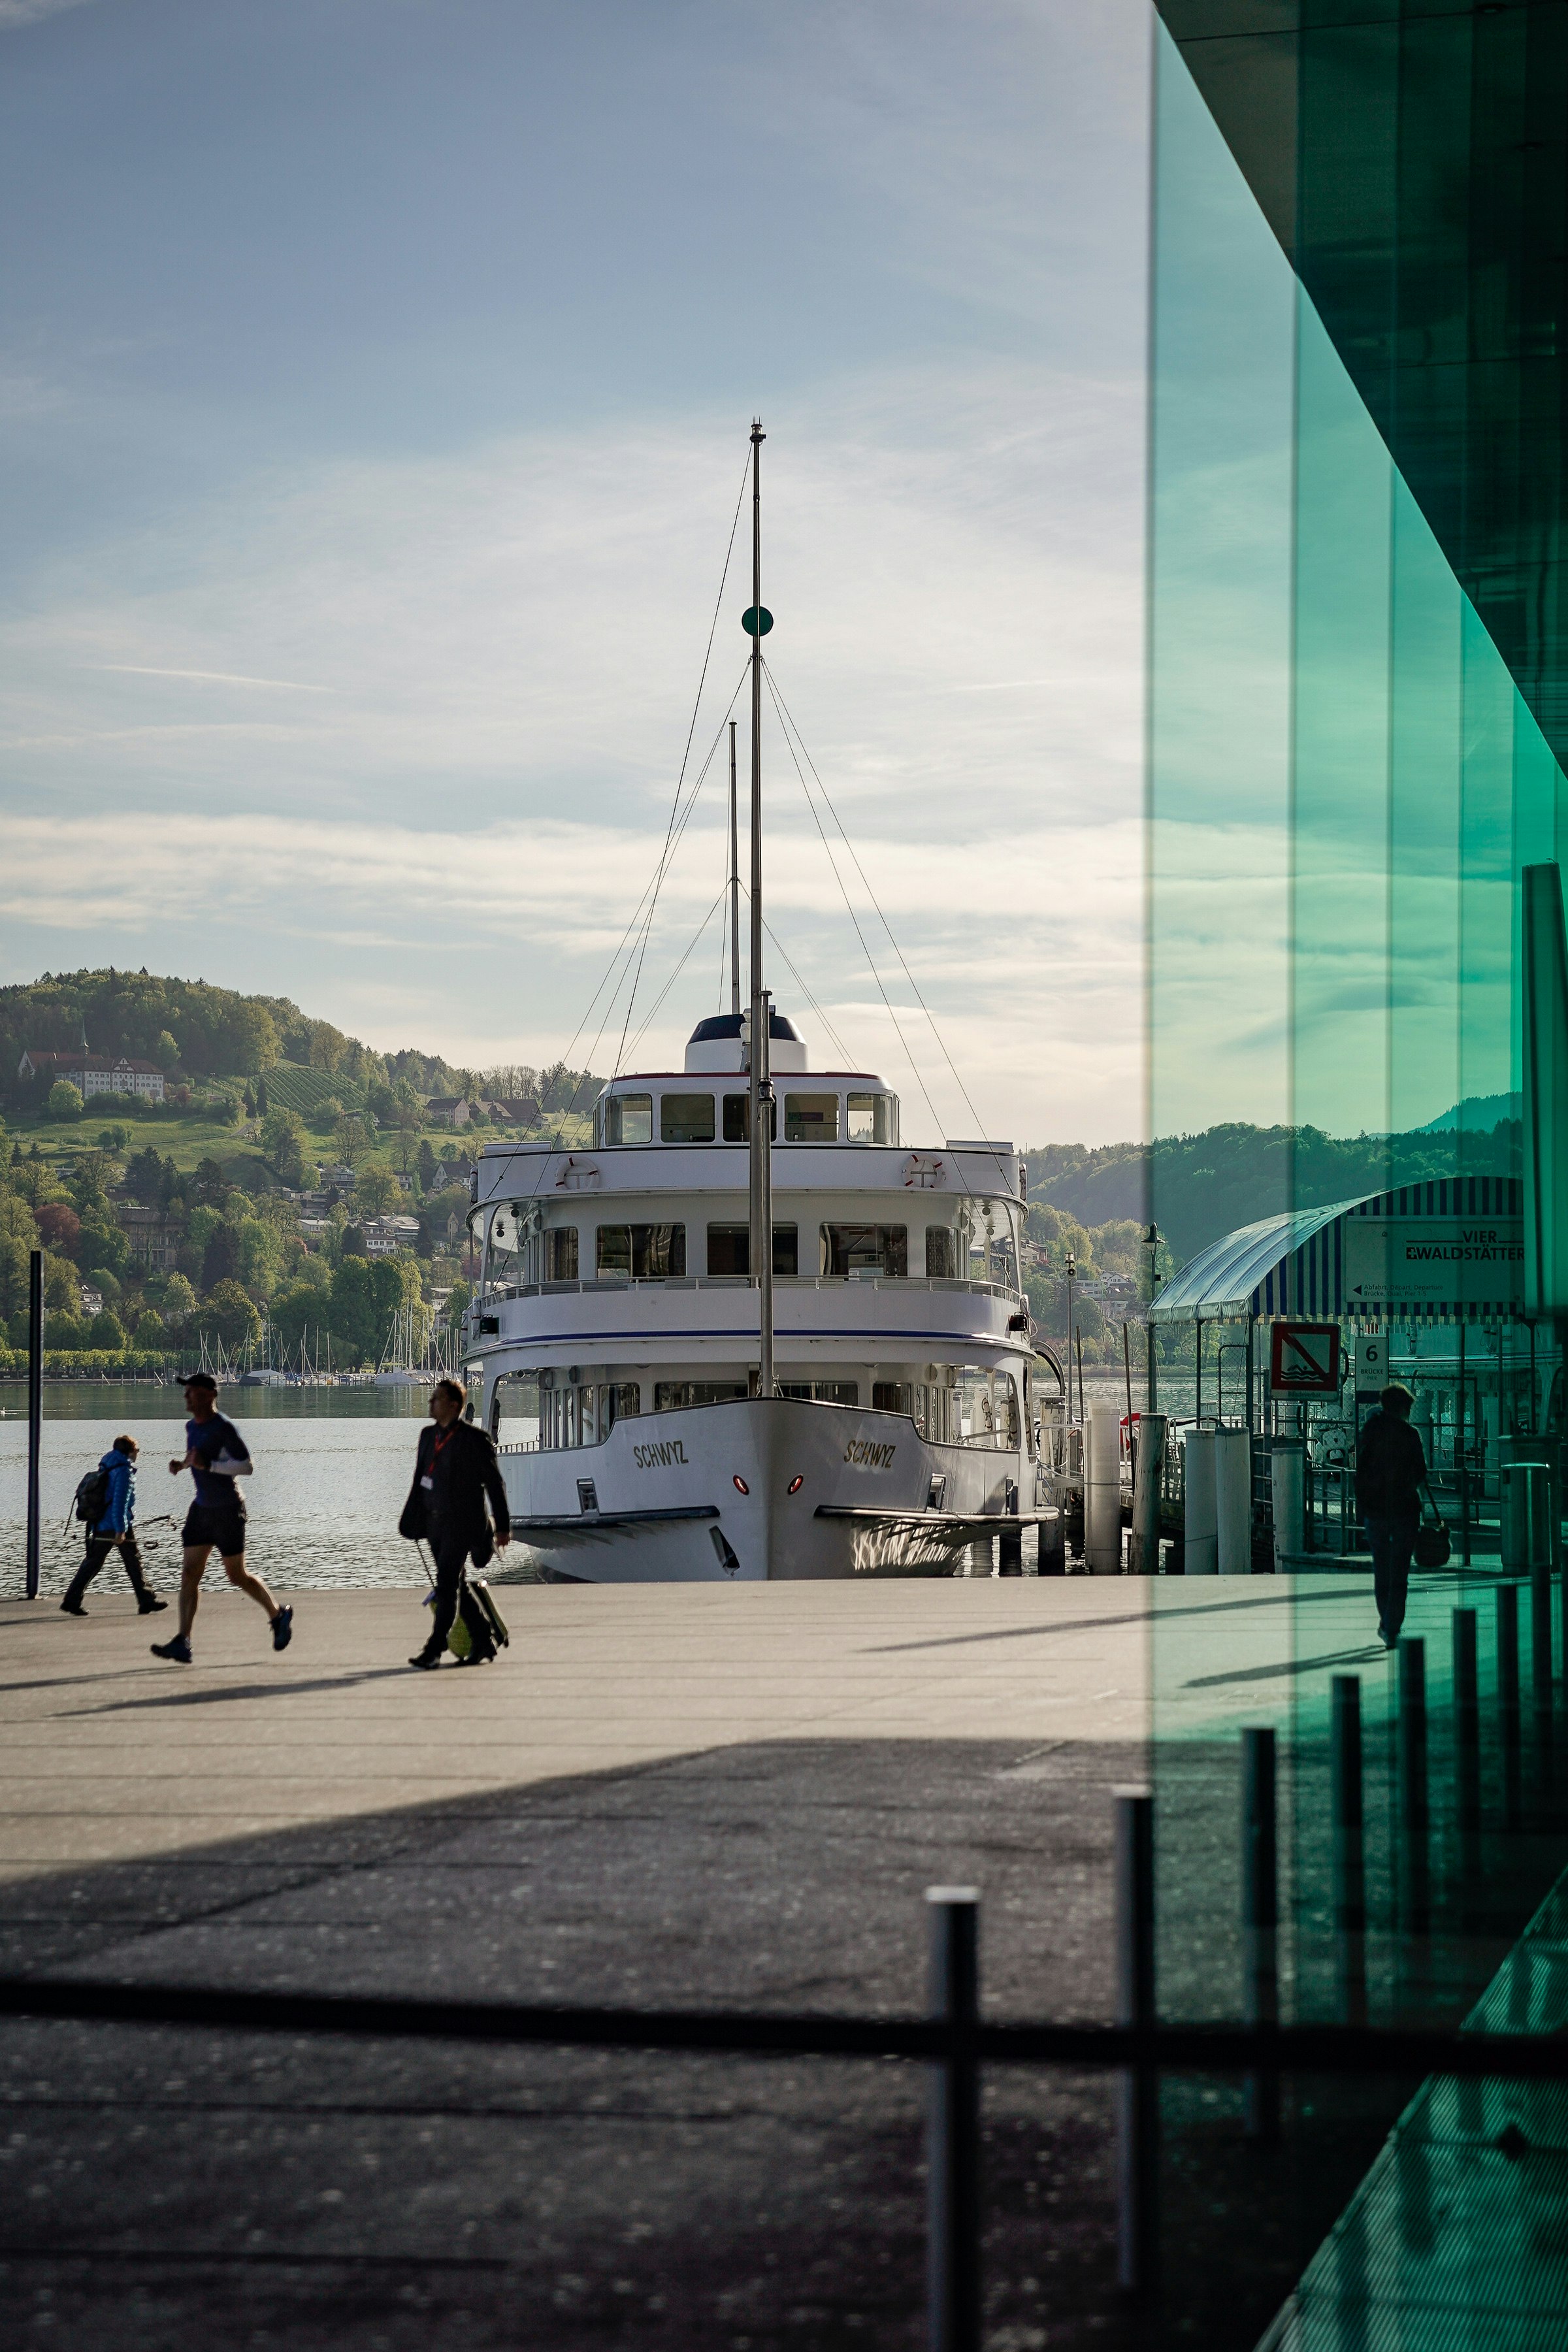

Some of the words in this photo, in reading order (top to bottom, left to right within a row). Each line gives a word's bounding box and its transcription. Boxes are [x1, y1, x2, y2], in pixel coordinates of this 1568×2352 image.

[1462, 1230, 1497, 1243] VIER
[1365, 1345, 1378, 1362] 6
[634, 1440, 689, 1469] SCHWYZ
[843, 1440, 896, 1468] SCHWYZ
